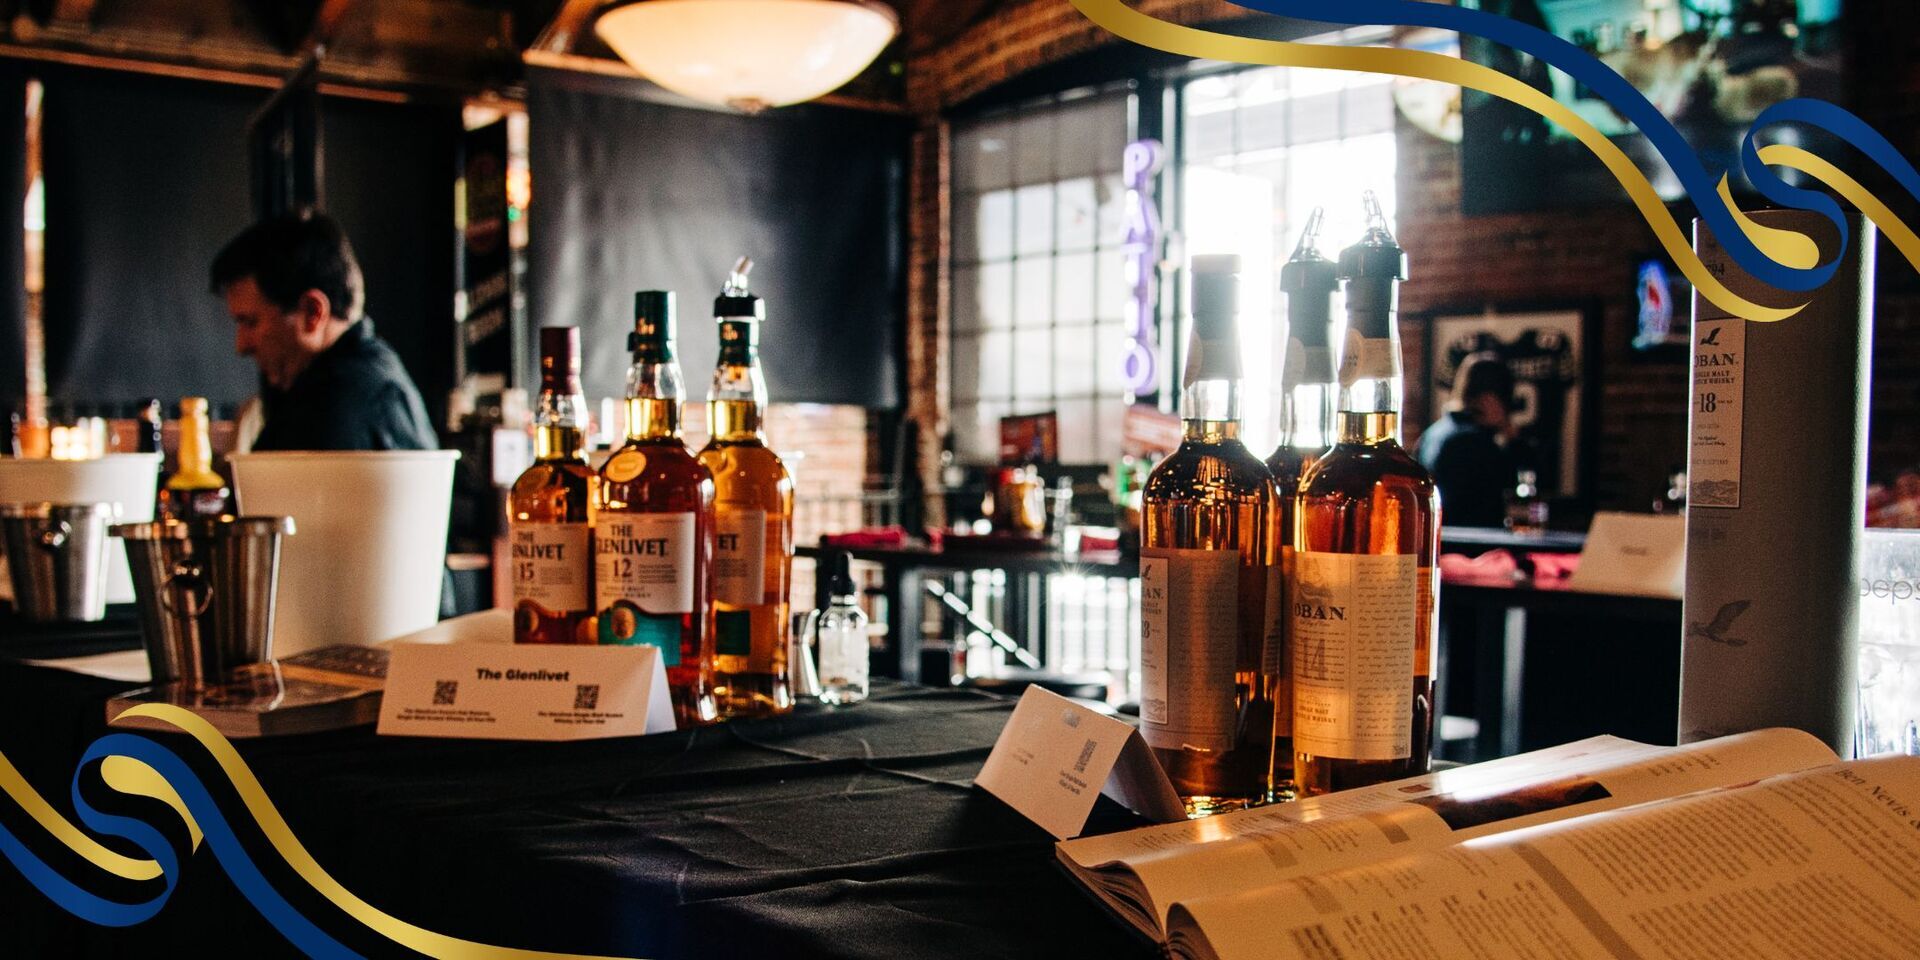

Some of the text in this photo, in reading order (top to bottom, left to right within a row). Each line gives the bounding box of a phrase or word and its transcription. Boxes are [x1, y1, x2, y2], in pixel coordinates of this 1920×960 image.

[1122, 140, 1162, 394] PATIO
[1699, 392, 1717, 413] 18
[611, 524, 633, 537] THE
[519, 562, 535, 580] 15
[613, 557, 633, 578] 12
[1858, 577, 1920, 605] ep
[1302, 637, 1328, 681] 14
[476, 667, 570, 682] The Glenlivet
[1868, 785, 1909, 816] Nevis
